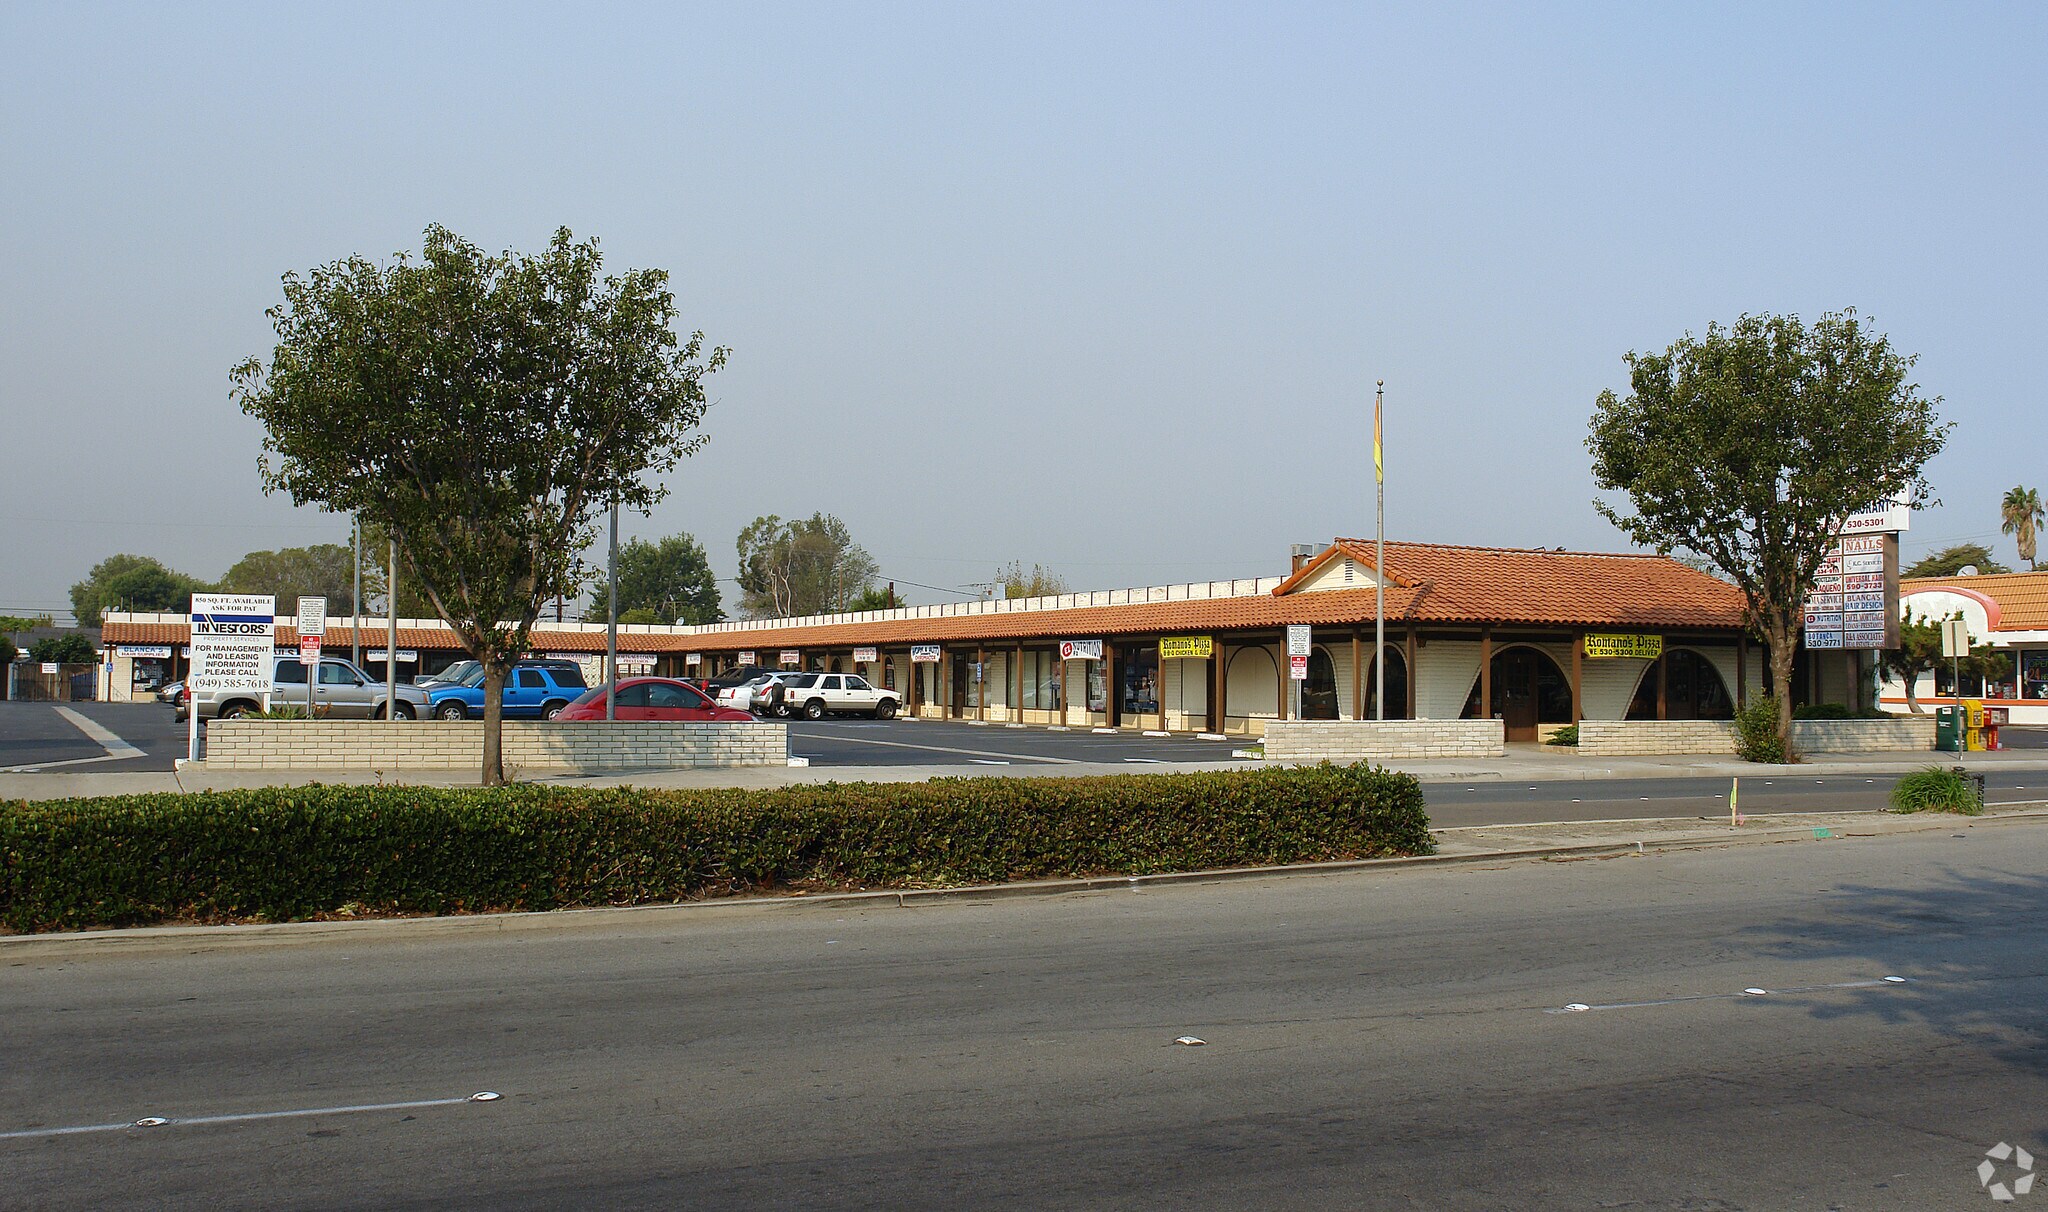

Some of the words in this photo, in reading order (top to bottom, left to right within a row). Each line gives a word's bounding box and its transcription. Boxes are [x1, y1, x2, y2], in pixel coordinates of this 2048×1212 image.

[1846, 518, 1884, 528] 530-5301
[1846, 539, 1883, 551] NAILS
[1846, 582, 1882, 590] 590-3733
[1847, 594, 1881, 602] BLANCA'S
[1845, 602, 1860, 610] HAIR
[1861, 601, 1883, 609] DESIGN
[1817, 614, 1842, 622] NUTRITION
[1163, 638, 1191, 649] Romano's
[1194, 637, 1210, 649] Pizza
[1586, 634, 1633, 648] Romano's
[1636, 635, 1660, 649] Pizza
[214, 645, 270, 653] MANAGEMENT
[1073, 640, 1101, 657] NUTRITION
[195, 678, 221, 689] (949)
[224, 679, 269, 689] 585-7618
